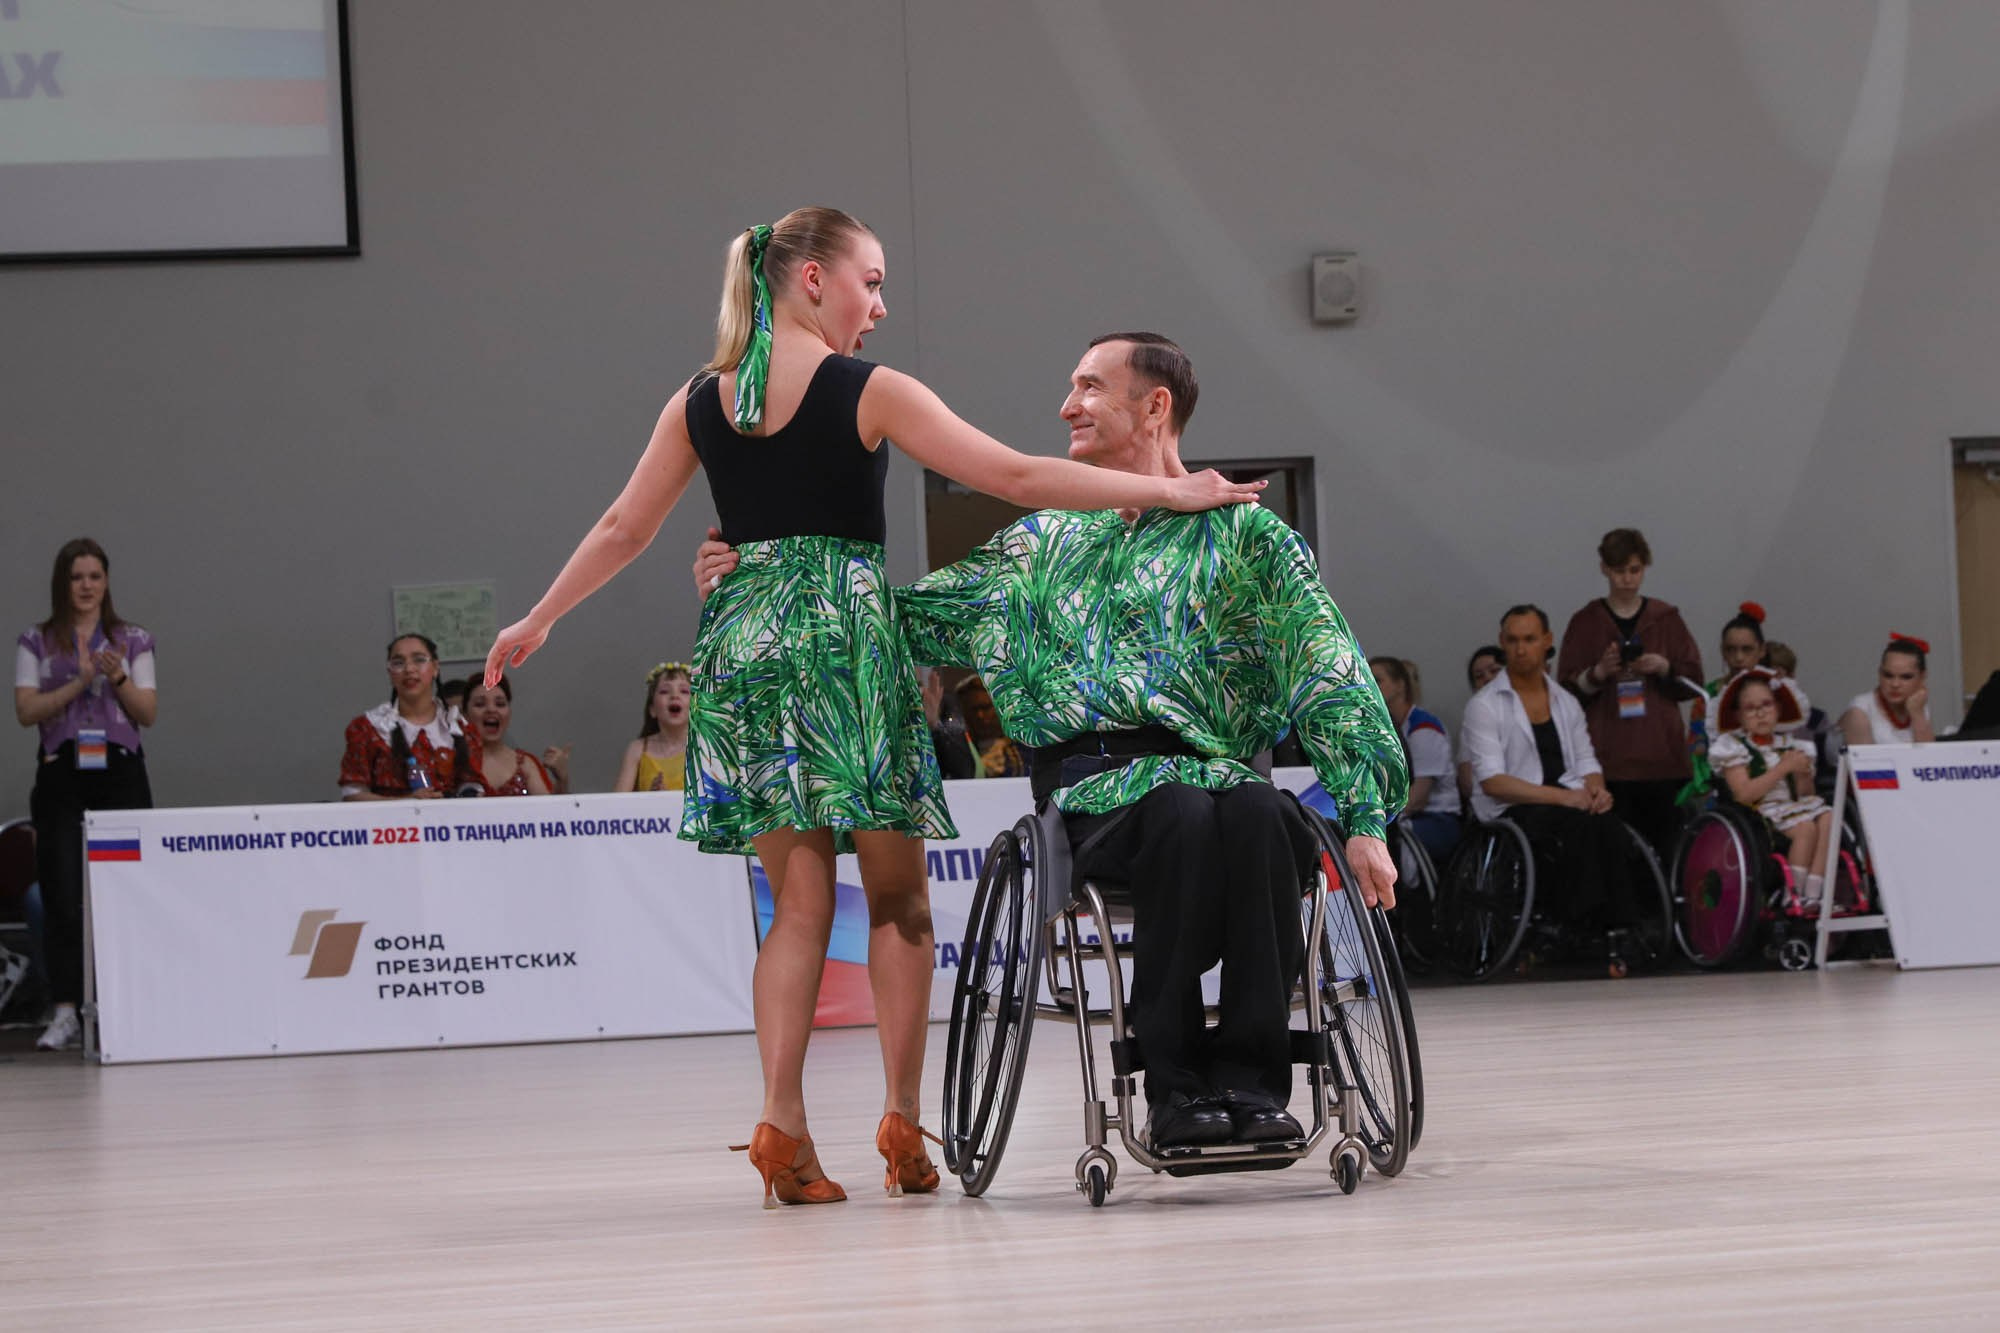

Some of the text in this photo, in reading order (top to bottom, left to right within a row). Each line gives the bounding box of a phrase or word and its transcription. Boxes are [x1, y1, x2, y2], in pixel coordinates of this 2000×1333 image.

[162, 817, 672, 853] ЧЕМПИОНАТ РОССИИ 2022 ПО ТАНЦАМ НА КОЛЯСКАХ
[374, 934, 445, 952] ФОНД
[376, 951, 577, 976] ПРЕЗИДЕНТСКИХ
[378, 979, 485, 999] ГРАНТОВ
